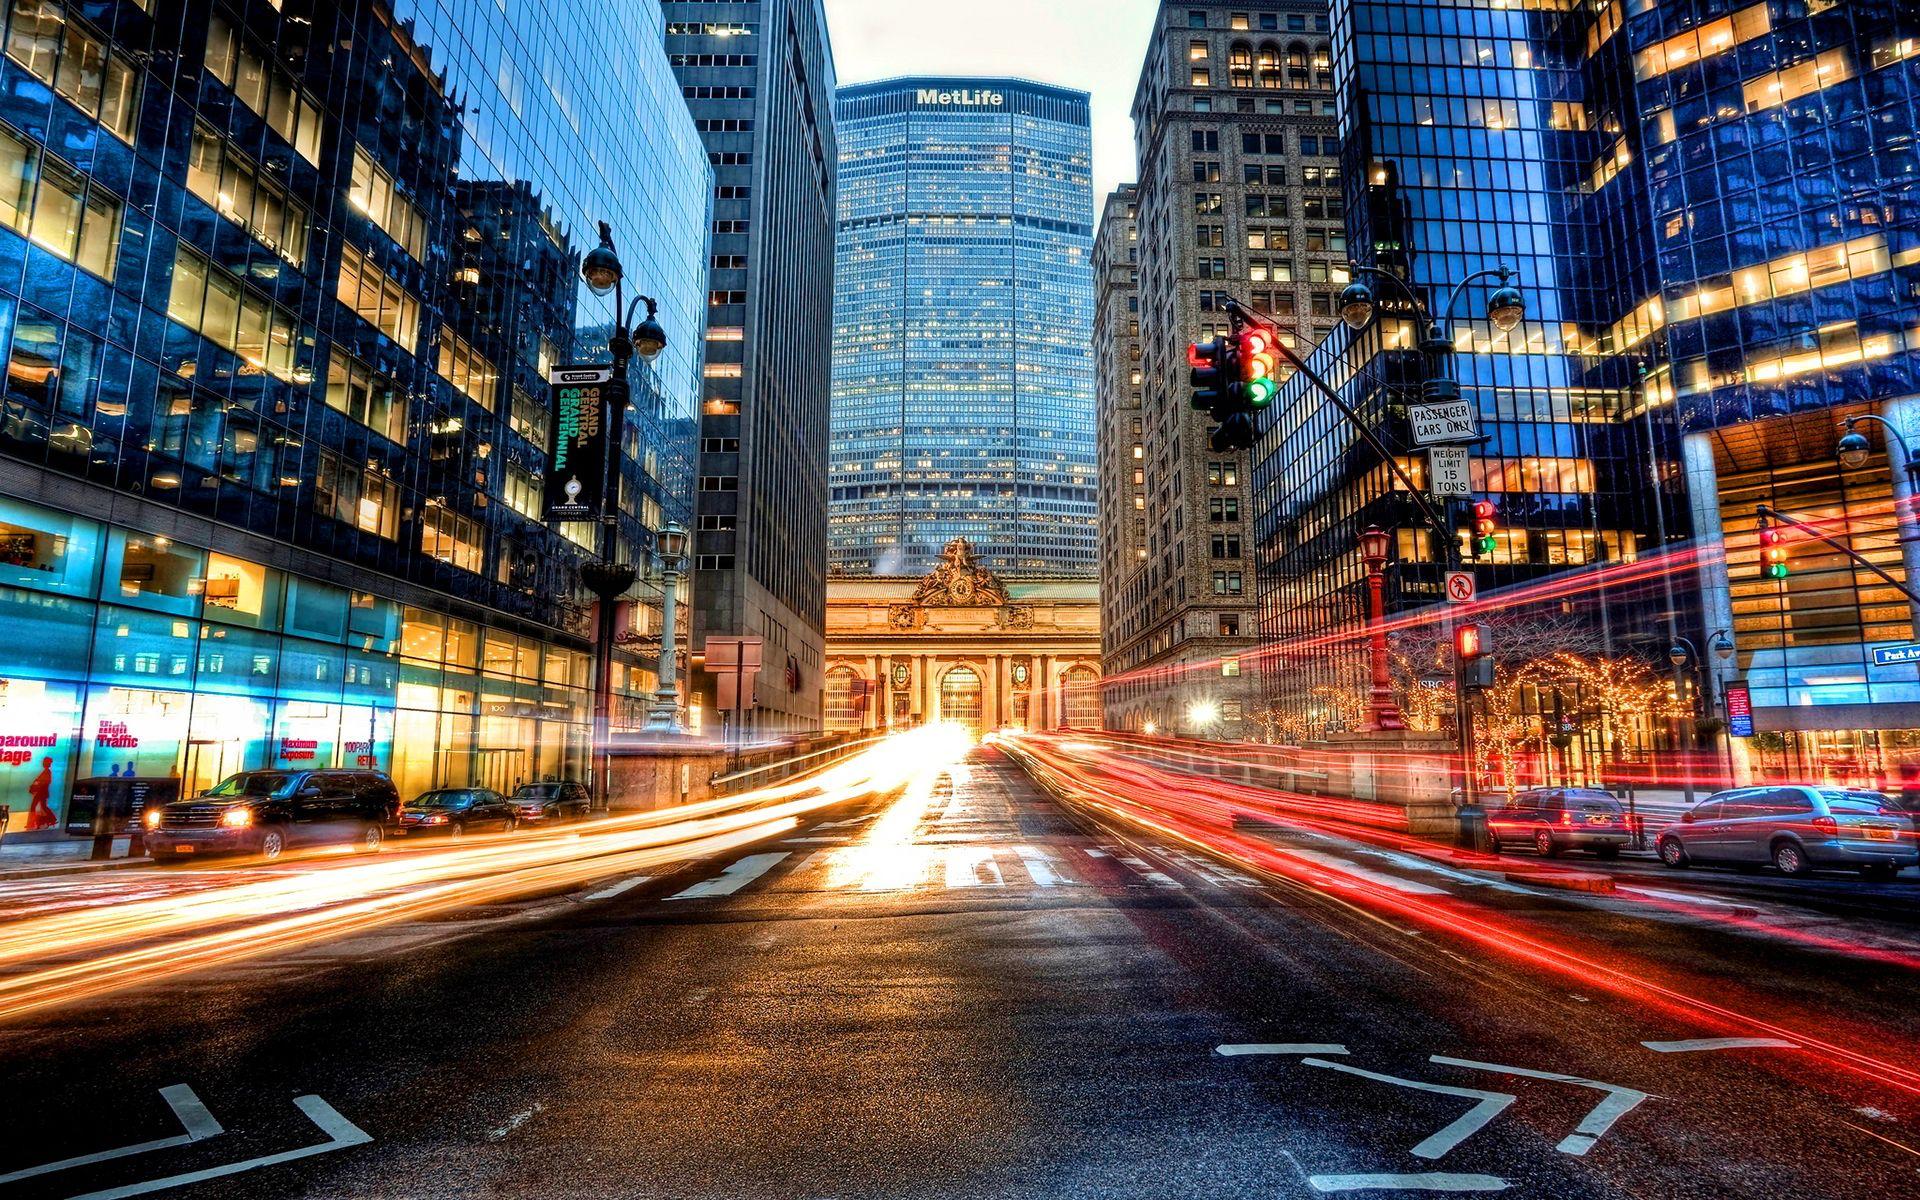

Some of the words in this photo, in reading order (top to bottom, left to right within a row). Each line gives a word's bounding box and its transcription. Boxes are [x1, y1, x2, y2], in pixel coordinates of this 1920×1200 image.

[917, 89, 1003, 105] MetLife
[569, 388, 580, 438] GRAND
[588, 387, 600, 436] GRAND
[1414, 406, 1468, 421] PASSENGER
[577, 388, 590, 449] CENTRAL
[555, 389, 570, 472] CENTENNIAL
[1417, 424, 1441, 436] CARS
[1447, 420, 1469, 432] ONLY
[1433, 450, 1465, 459] WEIGHT
[1438, 460, 1461, 468] LIMIT
[1444, 470, 1457, 480] 15
[1437, 482, 1467, 492] TONS
[1884, 650, 1907, 661] Park
[97, 734, 139, 748] Traffic
[281, 738, 317, 748] Maximum
[281, 749, 314, 761] Exposure
[357, 755, 378, 766] RETIL
